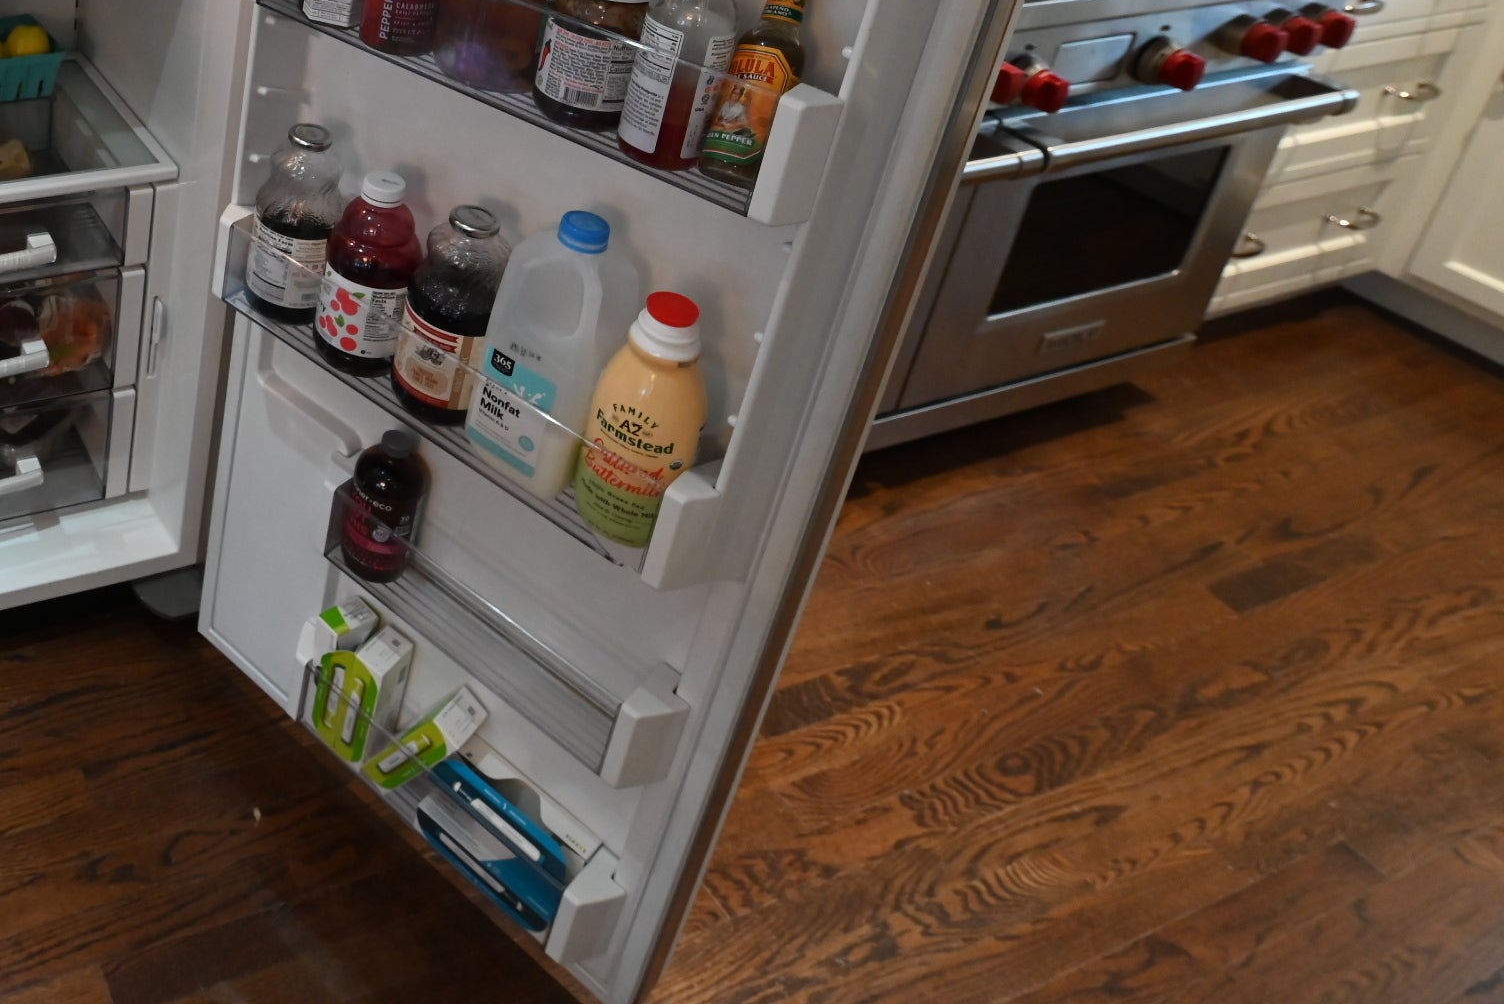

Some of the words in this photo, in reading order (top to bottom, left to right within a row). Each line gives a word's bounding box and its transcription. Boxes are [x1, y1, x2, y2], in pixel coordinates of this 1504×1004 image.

[721, 132, 753, 147] PEPPER
[493, 353, 513, 370] 365
[480, 397, 504, 421] Milk
[482, 386, 521, 419] Nonfat
[612, 403, 660, 430] FAMILY
[618, 419, 643, 437] A2
[596, 408, 675, 455] Farmstead
